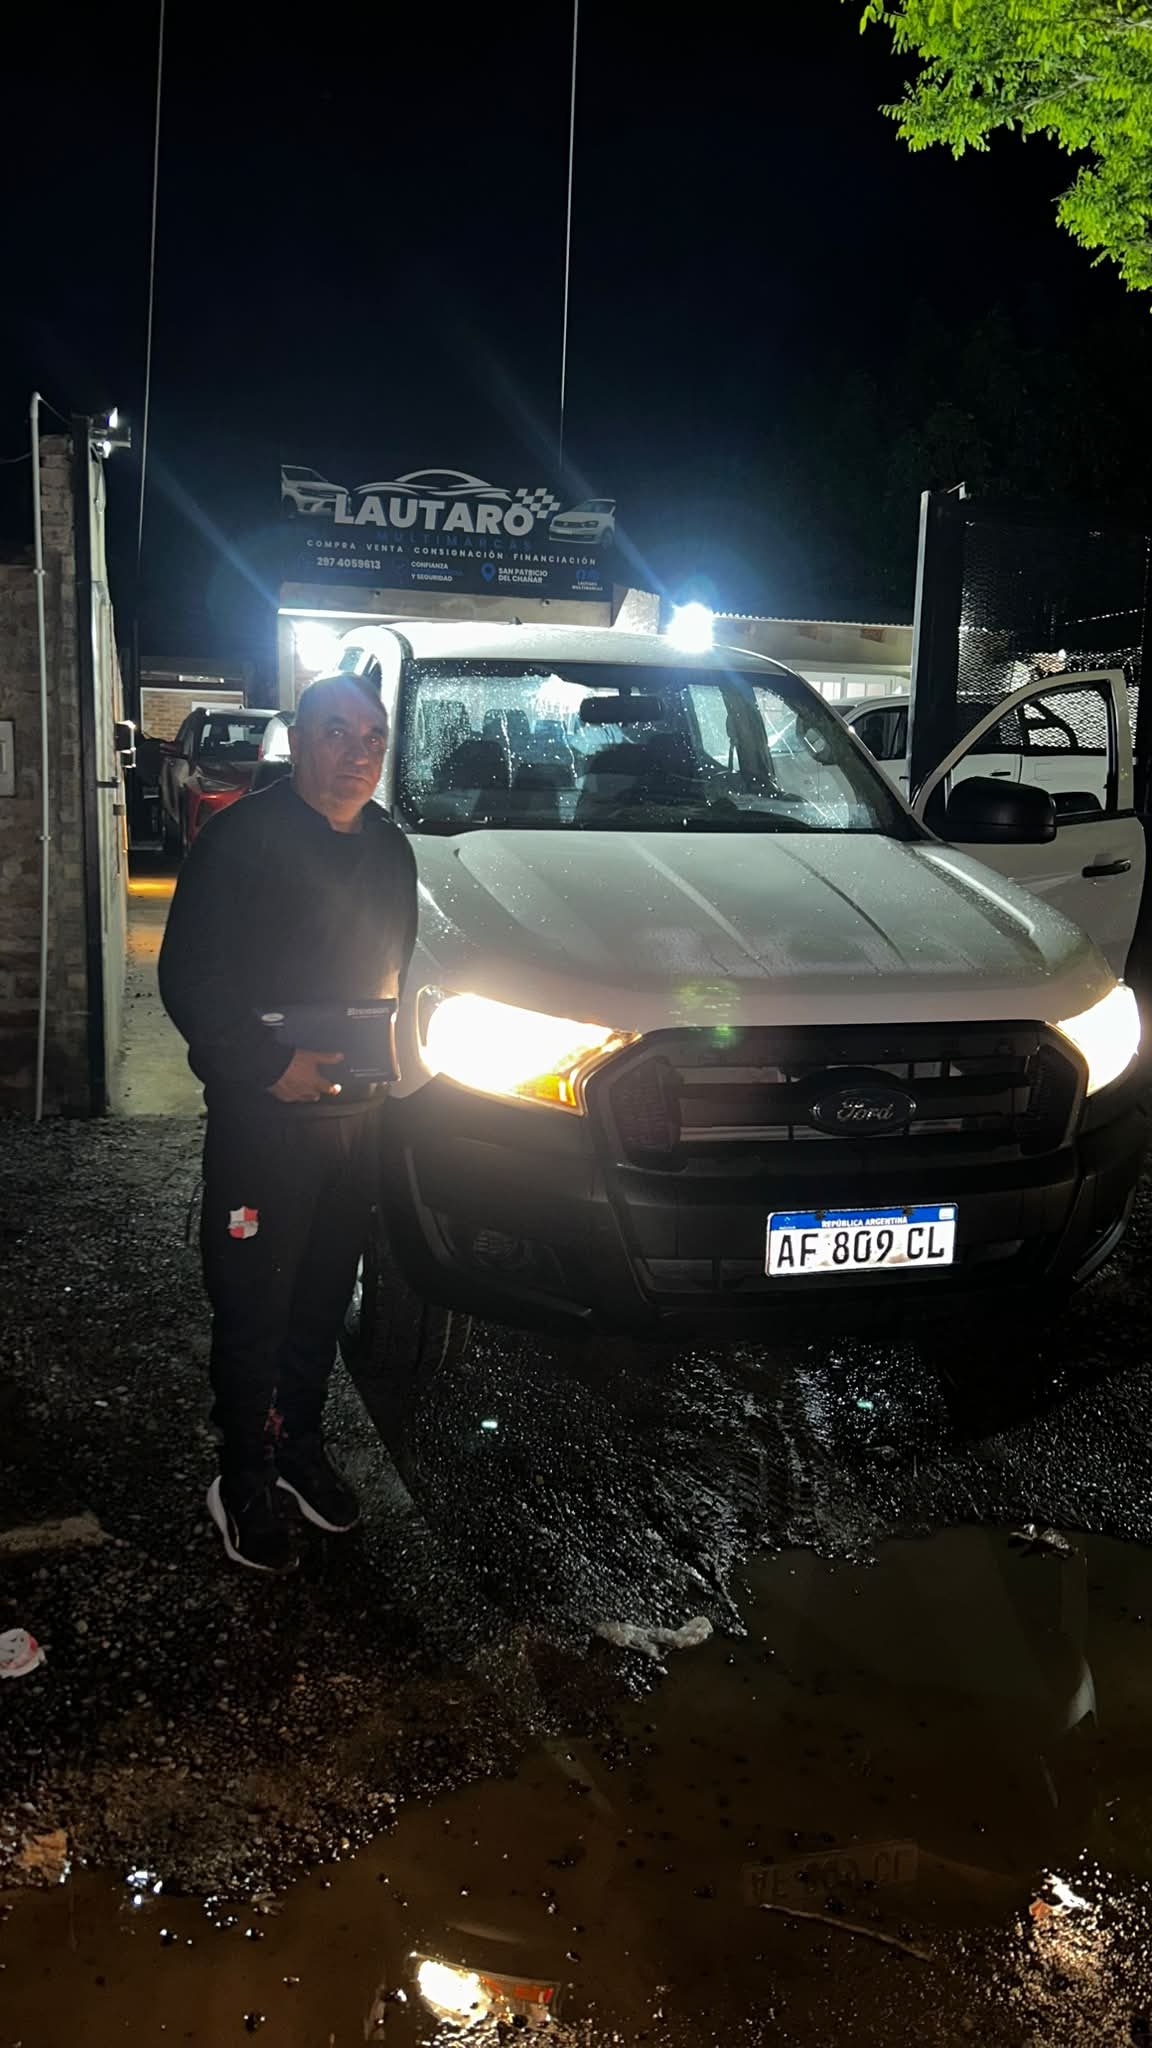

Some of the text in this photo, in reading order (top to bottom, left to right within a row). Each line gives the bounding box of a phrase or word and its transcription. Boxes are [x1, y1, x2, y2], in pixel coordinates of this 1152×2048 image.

[334, 493, 535, 536] LAUTARO
[306, 539, 597, 566] COMPRA VENTA CONSIGNACIÓN FINANCIACIÓN
[410, 561, 449, 570] CONFIANZA
[498, 567, 549, 577] SAN PATRICIO
[498, 574, 511, 582] DEL
[836, 1099, 897, 1121] Ford
[821, 1215, 908, 1229] REPÚBLICA ARGENTINA
[777, 1221, 945, 1268] AF 809 CL
